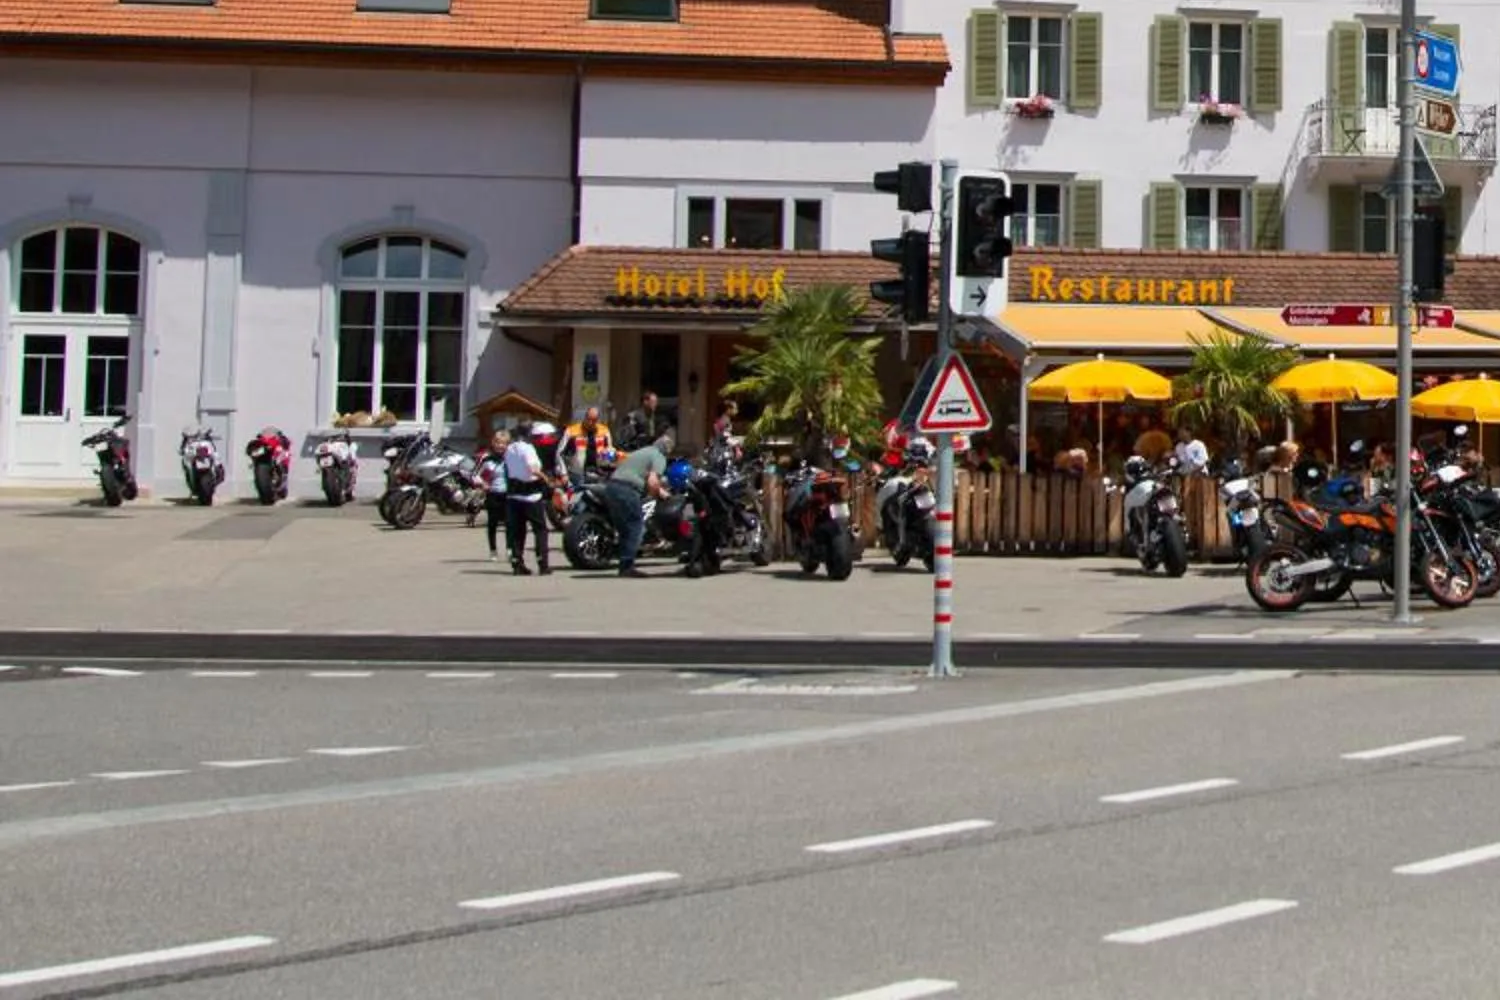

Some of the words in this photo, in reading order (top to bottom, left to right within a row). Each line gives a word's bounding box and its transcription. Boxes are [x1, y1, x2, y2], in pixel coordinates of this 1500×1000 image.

[615, 264, 705, 298] Hotel
[724, 265, 786, 302] Hof
[1028, 264, 1235, 304] Restaurant
